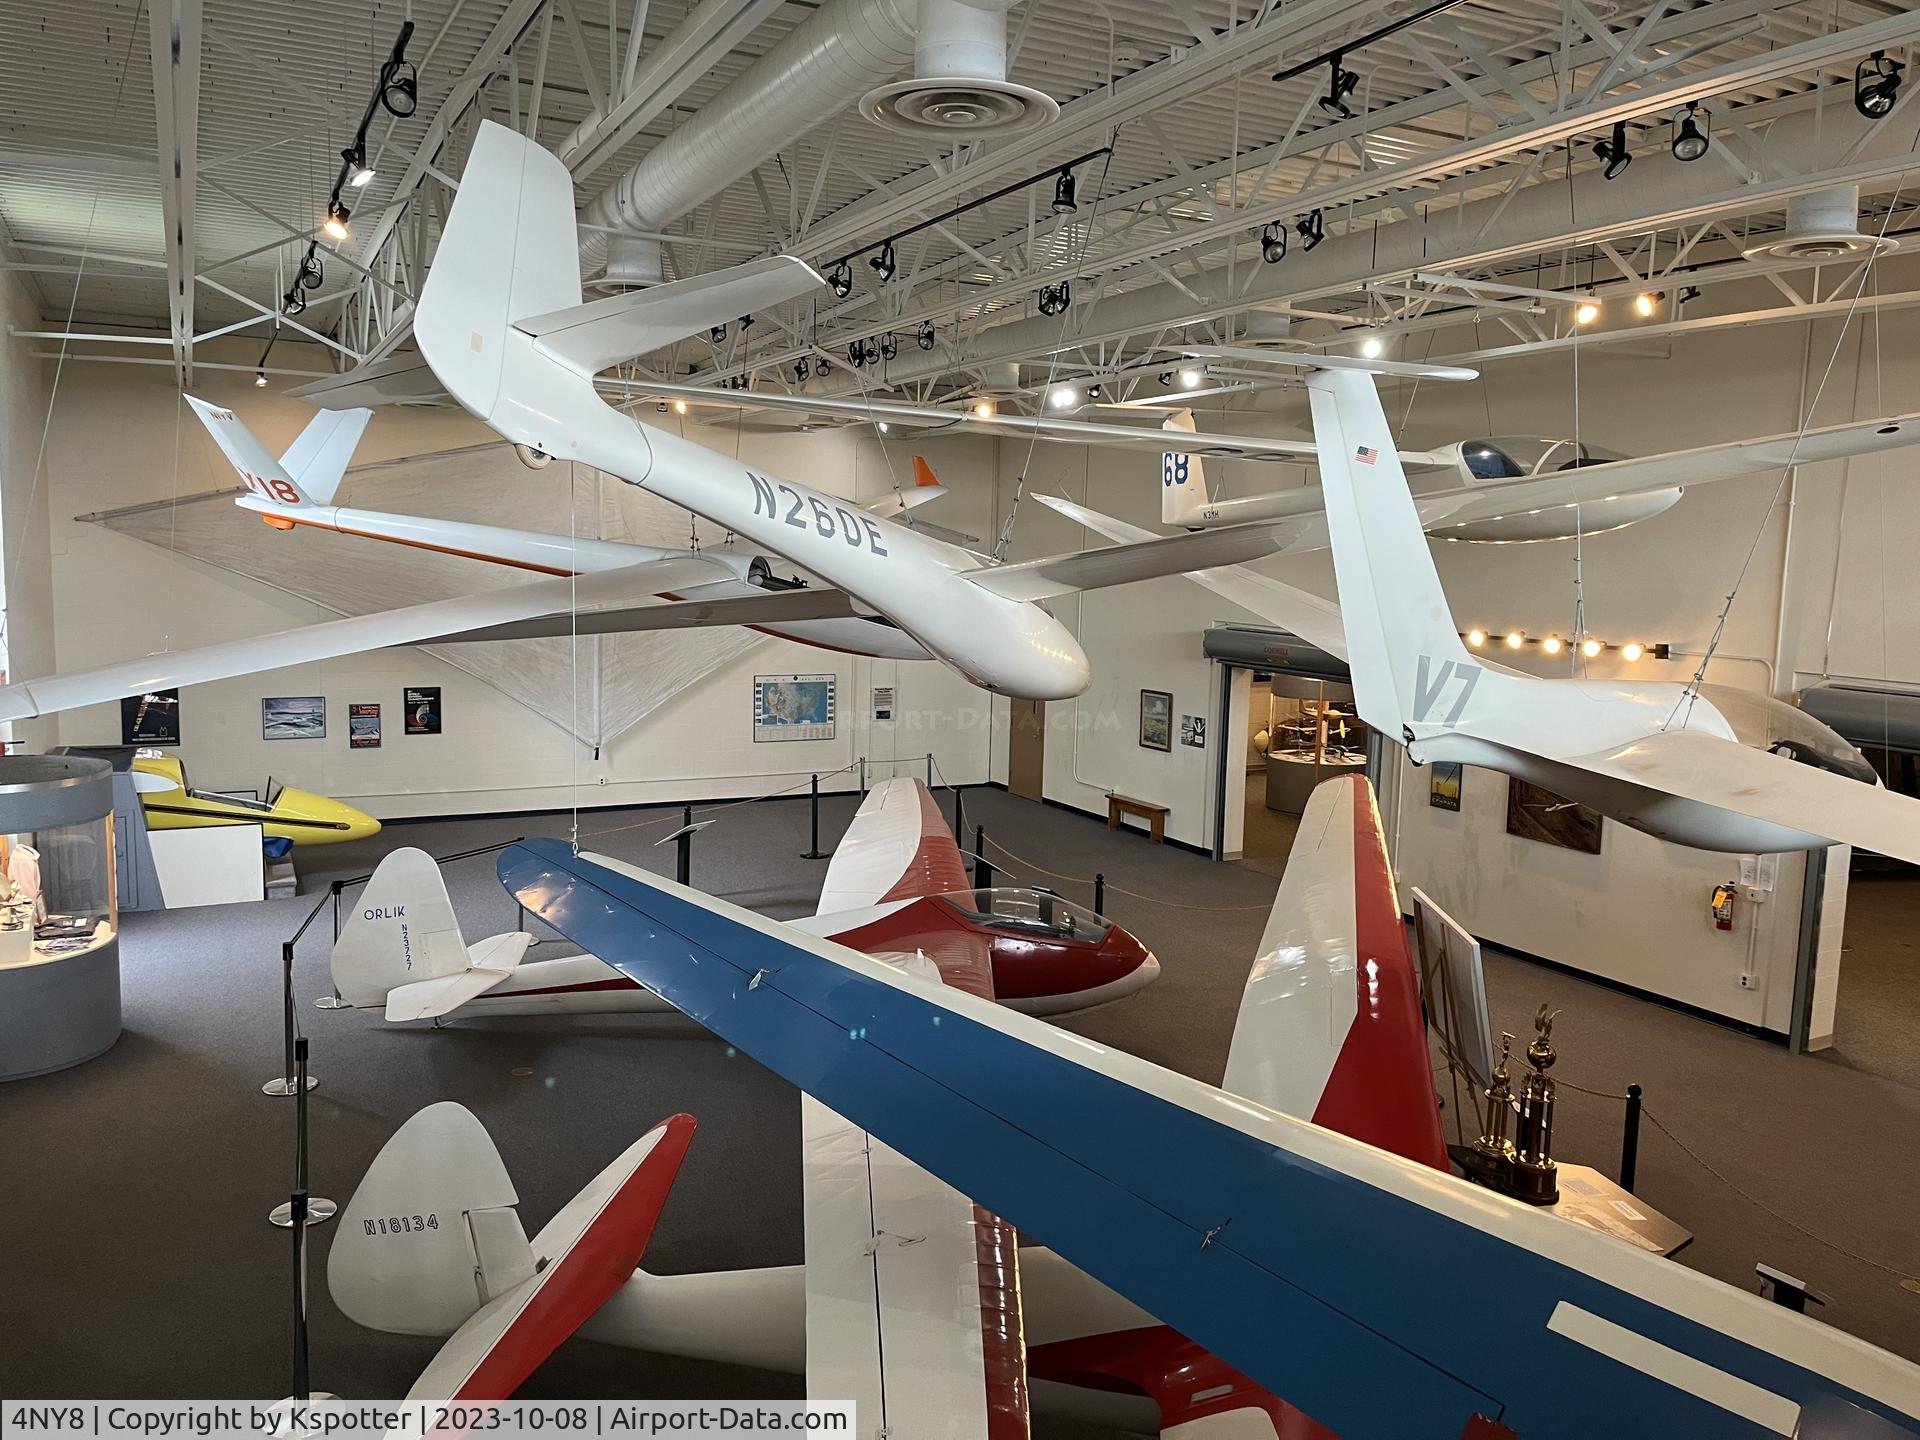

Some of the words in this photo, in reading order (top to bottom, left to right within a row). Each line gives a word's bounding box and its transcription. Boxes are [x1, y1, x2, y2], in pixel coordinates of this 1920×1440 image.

[1164, 452, 1189, 487] 68
[1412, 654, 1482, 729] V7
[364, 906, 405, 921] ORLIK
[402, 923, 412, 971] N23727
[364, 1214, 438, 1236] N18134
